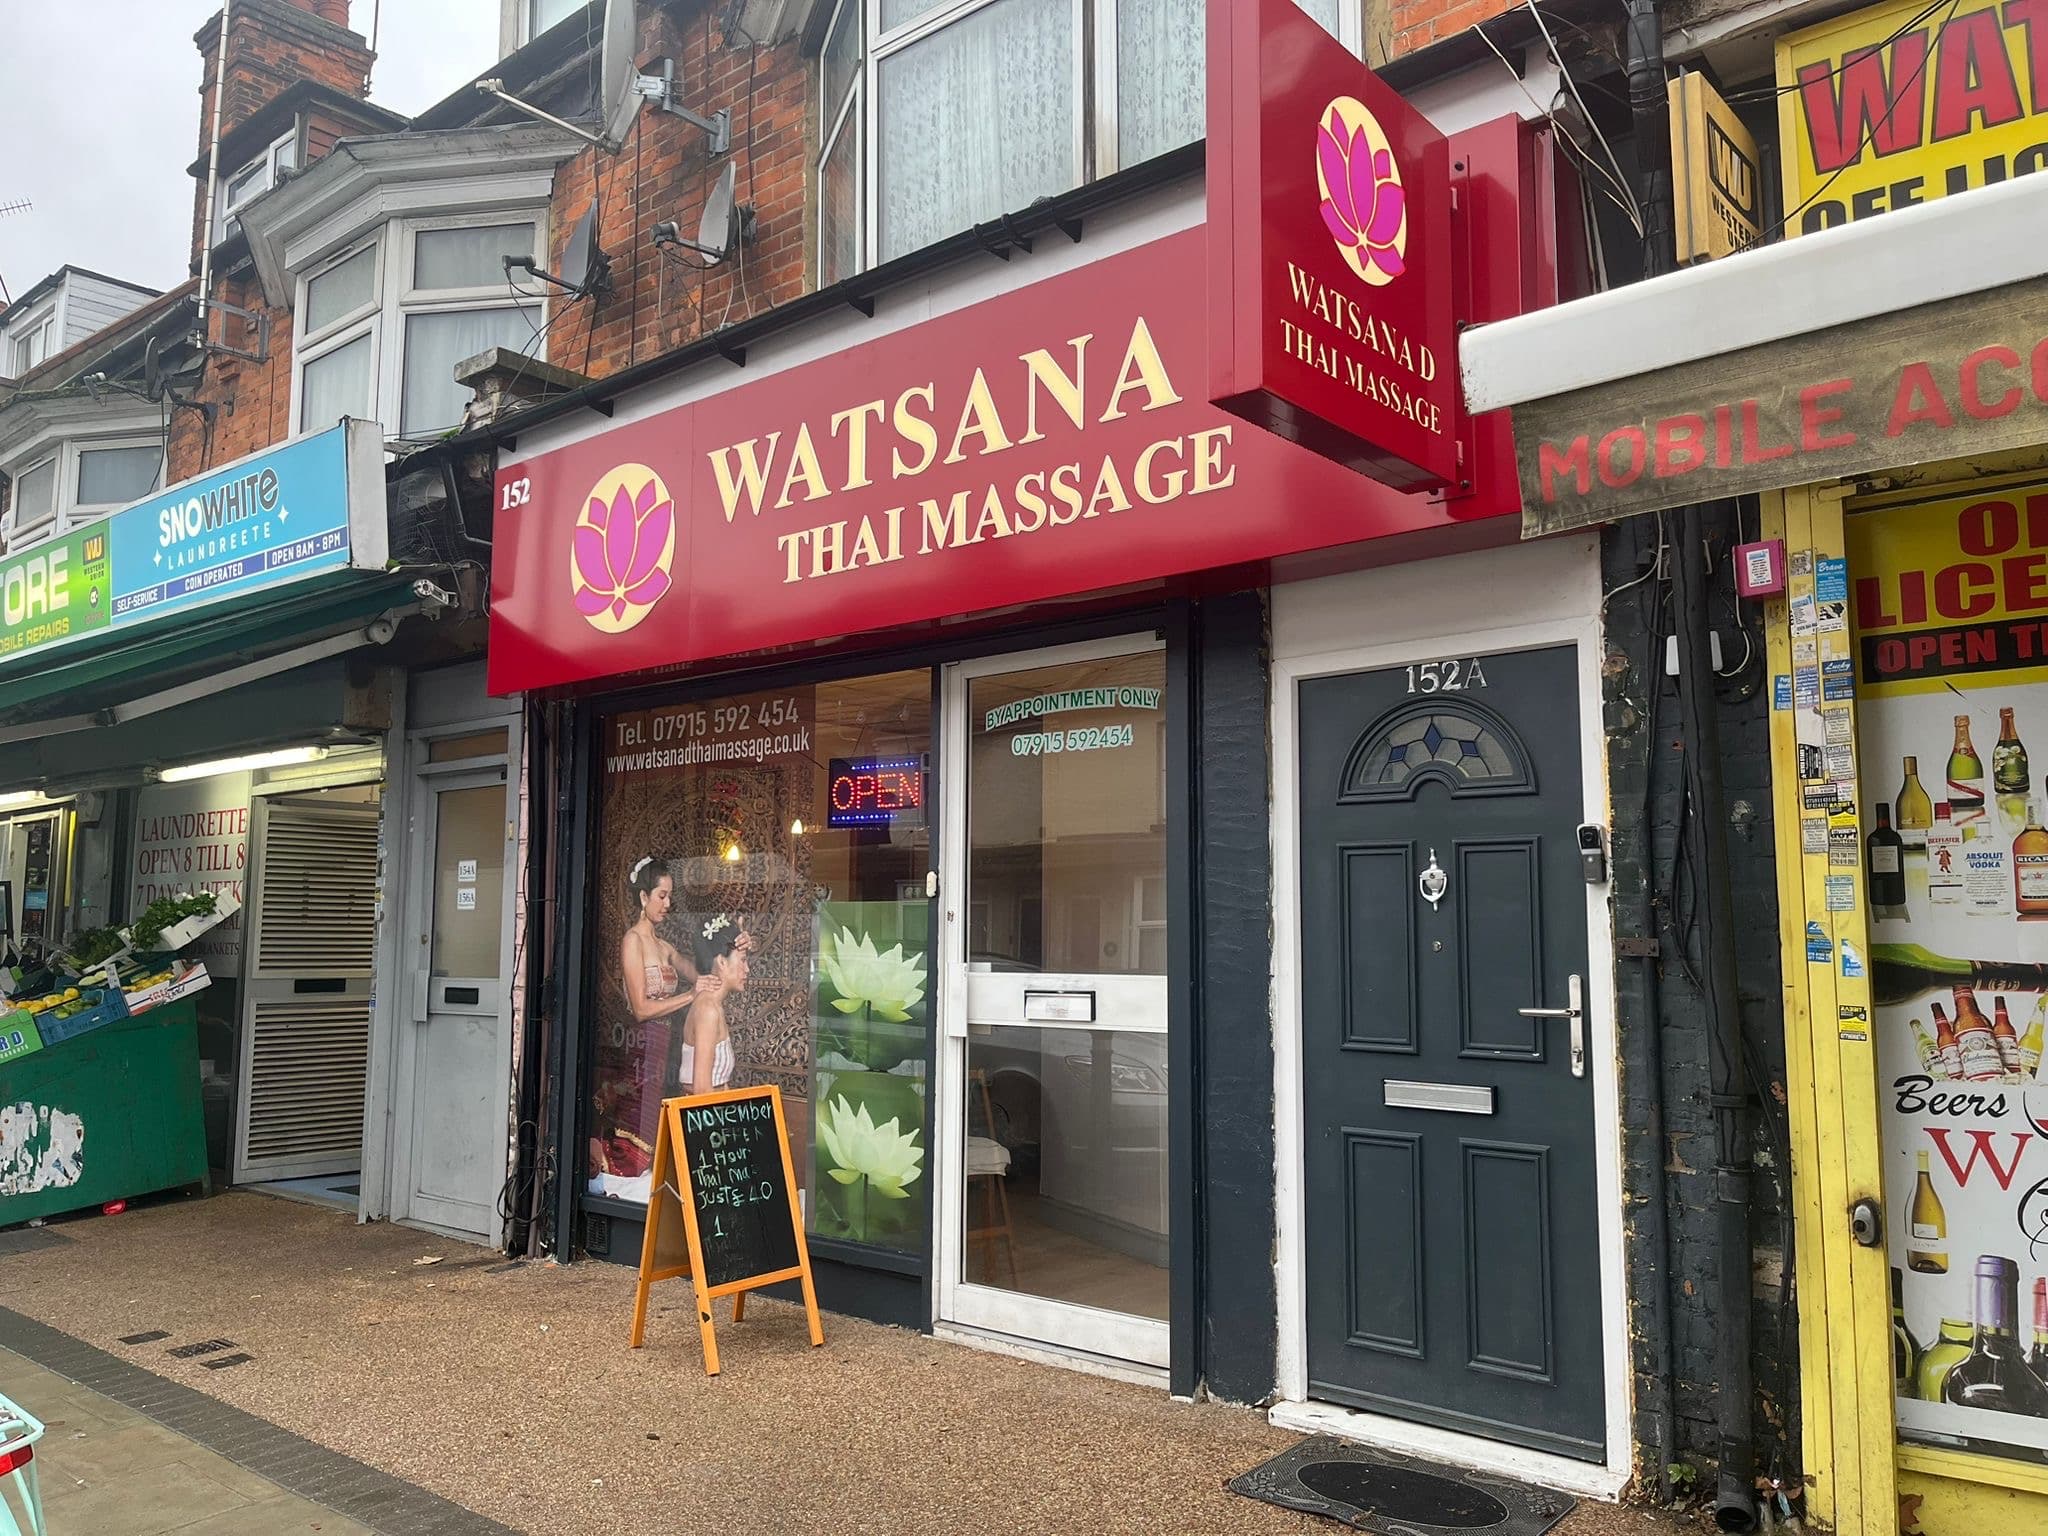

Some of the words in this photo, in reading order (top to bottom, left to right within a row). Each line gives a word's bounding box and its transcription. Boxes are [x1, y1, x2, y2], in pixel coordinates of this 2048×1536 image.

[1280, 318, 1338, 379] THAI
[1345, 355, 1442, 435] MASSAGE
[706, 316, 1183, 523] WATSANA
[1538, 378, 1857, 504] MOBILE
[502, 477, 531, 511] 152
[777, 507, 905, 584] THAI
[917, 425, 1237, 555] MASSAGE
[168, 521, 271, 570] LAUNDREETE
[272, 545, 294, 566] OPEN
[296, 538, 315, 559] 8AM
[322, 530, 342, 551] 8PM
[0, 545, 69, 626] ORE
[185, 575, 202, 592] COIN
[203, 562, 243, 587] OPERATED
[117, 588, 158, 612] SELF-SERVICE
[26, 616, 70, 645] REPAIRS
[1876, 628, 1997, 673] OPEN
[1405, 657, 1489, 694] 152A
[1119, 686, 1162, 710] ONLY
[617, 721, 647, 747] Tel.
[652, 710, 707, 741] 07915
[713, 704, 751, 733] 592
[757, 697, 799, 727] 454
[1011, 733, 1065, 756] 07915
[1066, 724, 1134, 751] 592454
[607, 726, 810, 773] www.watsanadthaimassage.co.uk
[832, 770, 921, 811] OPEN
[141, 808, 248, 843] LAUNDRETTE
[139, 847, 180, 875] OPEN
[184, 847, 192, 872] 8
[197, 844, 232, 872] TILL
[236, 842, 245, 869] 8
[1965, 852, 2003, 860] ABSOLUT
[1969, 861, 2001, 869] VODKA
[1892, 1074, 2010, 1119] Beers
[692, 1166, 722, 1188] Thai
[698, 1149, 712, 1169] 1
